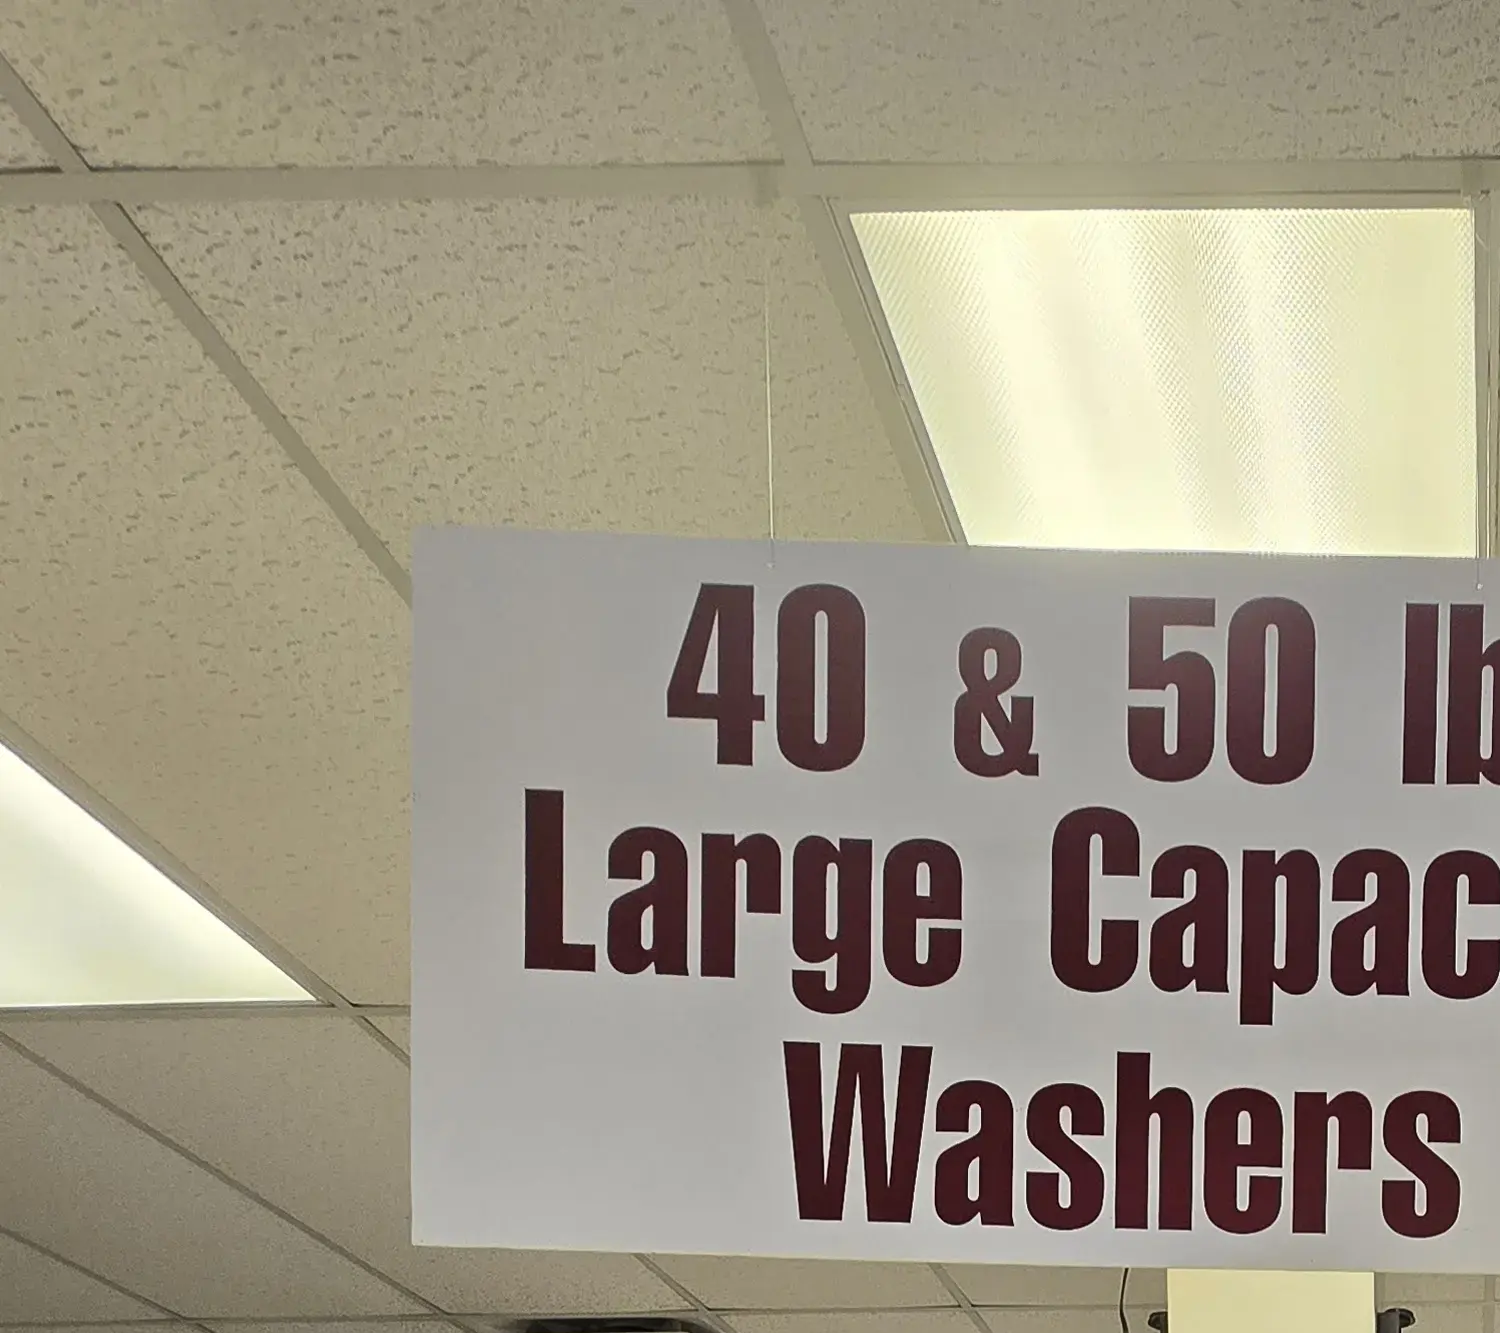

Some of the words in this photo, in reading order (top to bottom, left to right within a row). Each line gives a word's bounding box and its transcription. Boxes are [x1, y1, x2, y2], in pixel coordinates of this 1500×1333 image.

[666, 583, 866, 771] 40
[954, 627, 1039, 776] &
[1126, 596, 1315, 784] 50
[523, 789, 963, 1014] Large
[783, 1040, 1461, 1238] Washers
